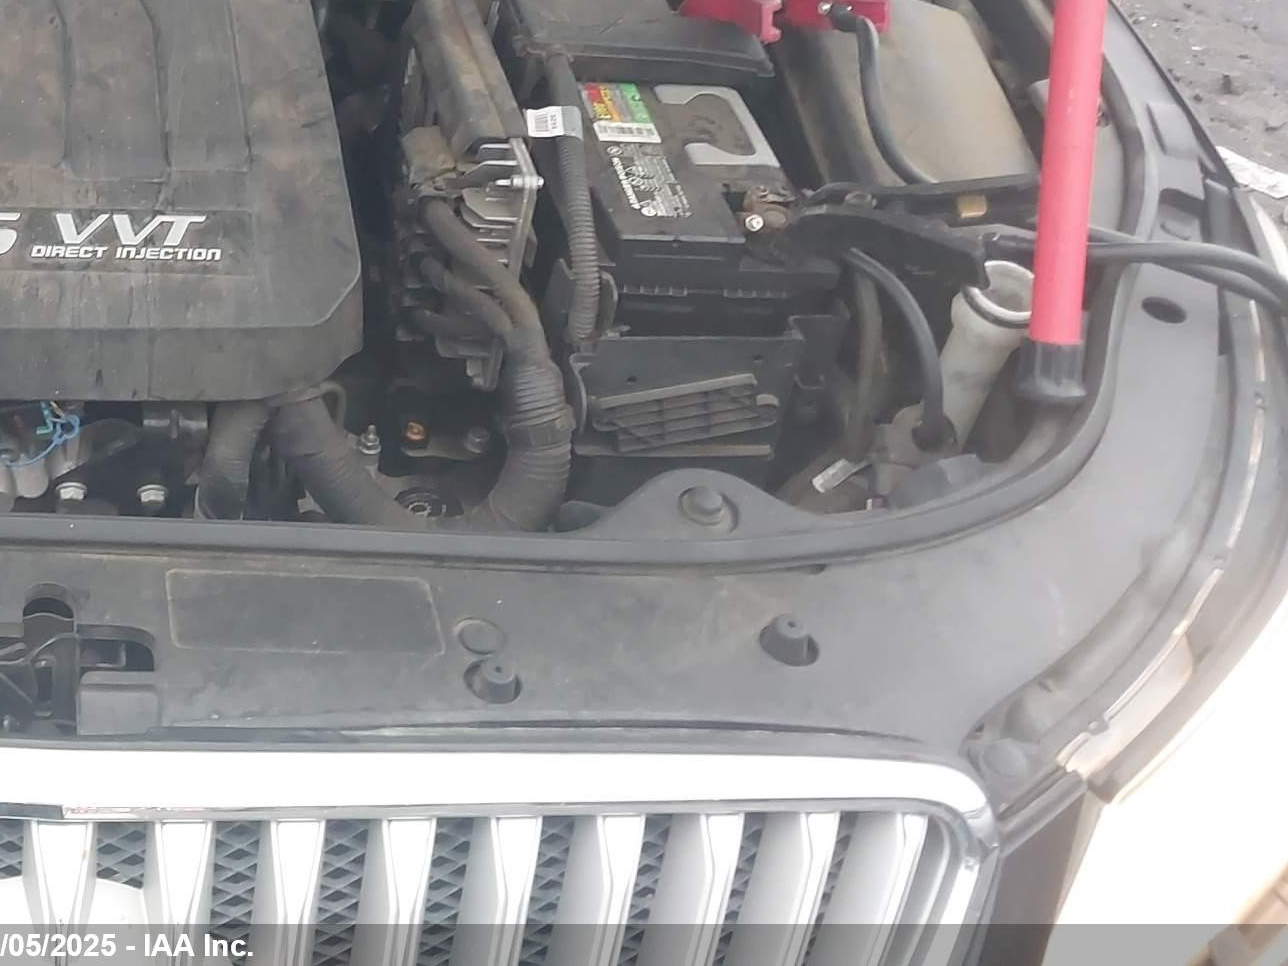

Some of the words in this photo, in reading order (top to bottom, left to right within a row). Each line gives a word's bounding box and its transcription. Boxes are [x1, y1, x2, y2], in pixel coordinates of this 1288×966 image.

[56, 213, 207, 246] VVT
[30, 245, 108, 260] DIRECT
[115, 246, 222, 262] INJECTION
